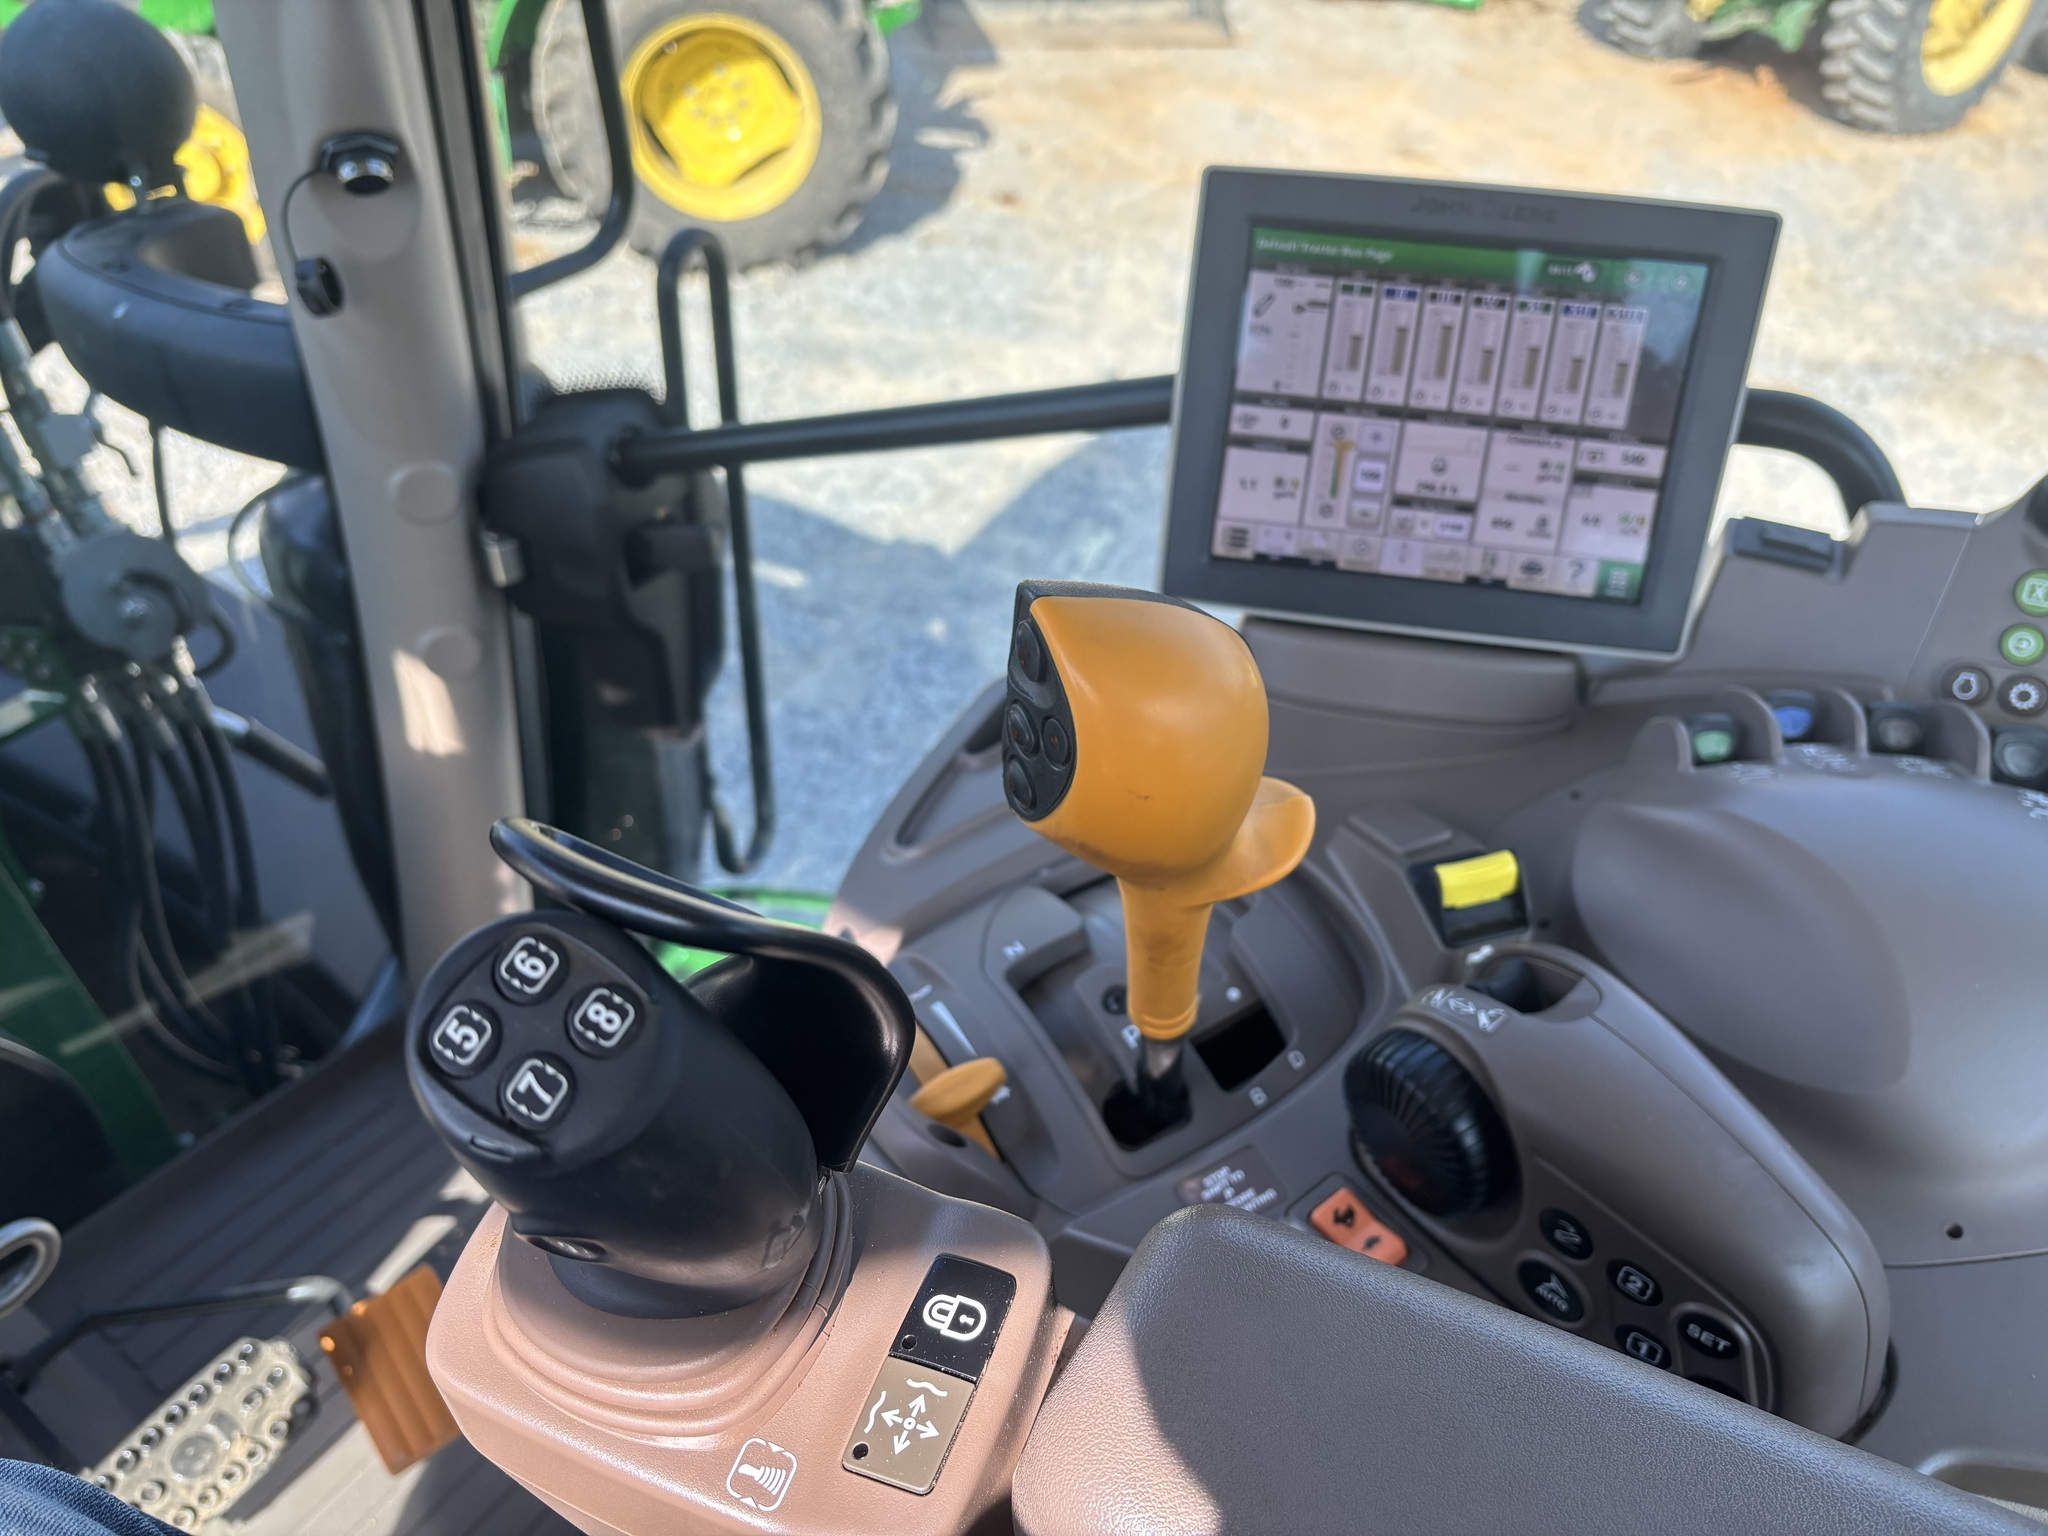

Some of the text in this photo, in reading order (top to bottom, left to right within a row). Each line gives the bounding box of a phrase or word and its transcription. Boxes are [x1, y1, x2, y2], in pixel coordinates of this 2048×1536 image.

[513, 950, 547, 979] 6
[586, 1002, 622, 1034] 8
[445, 1018, 480, 1051] 5
[1121, 1024, 1142, 1049] P
[516, 1070, 552, 1105] 7
[1686, 1322, 1731, 1352] SET
